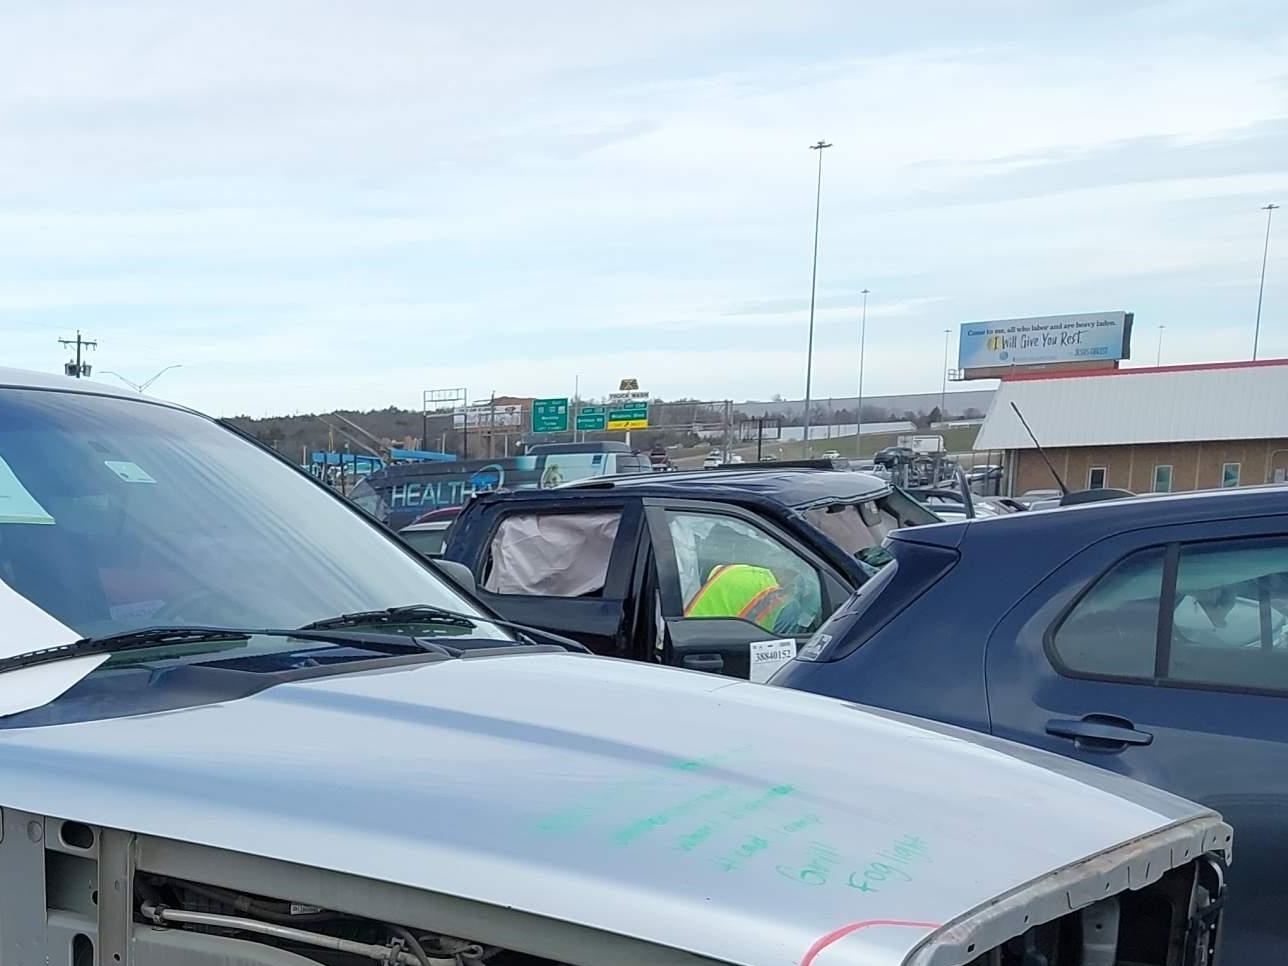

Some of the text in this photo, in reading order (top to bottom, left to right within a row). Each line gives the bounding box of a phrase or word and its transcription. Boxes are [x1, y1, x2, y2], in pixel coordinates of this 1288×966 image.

[1001, 334, 1017, 350] Will
[1020, 334, 1039, 349] Give
[1042, 332, 1057, 348] You
[392, 481, 476, 507] HEALTH
